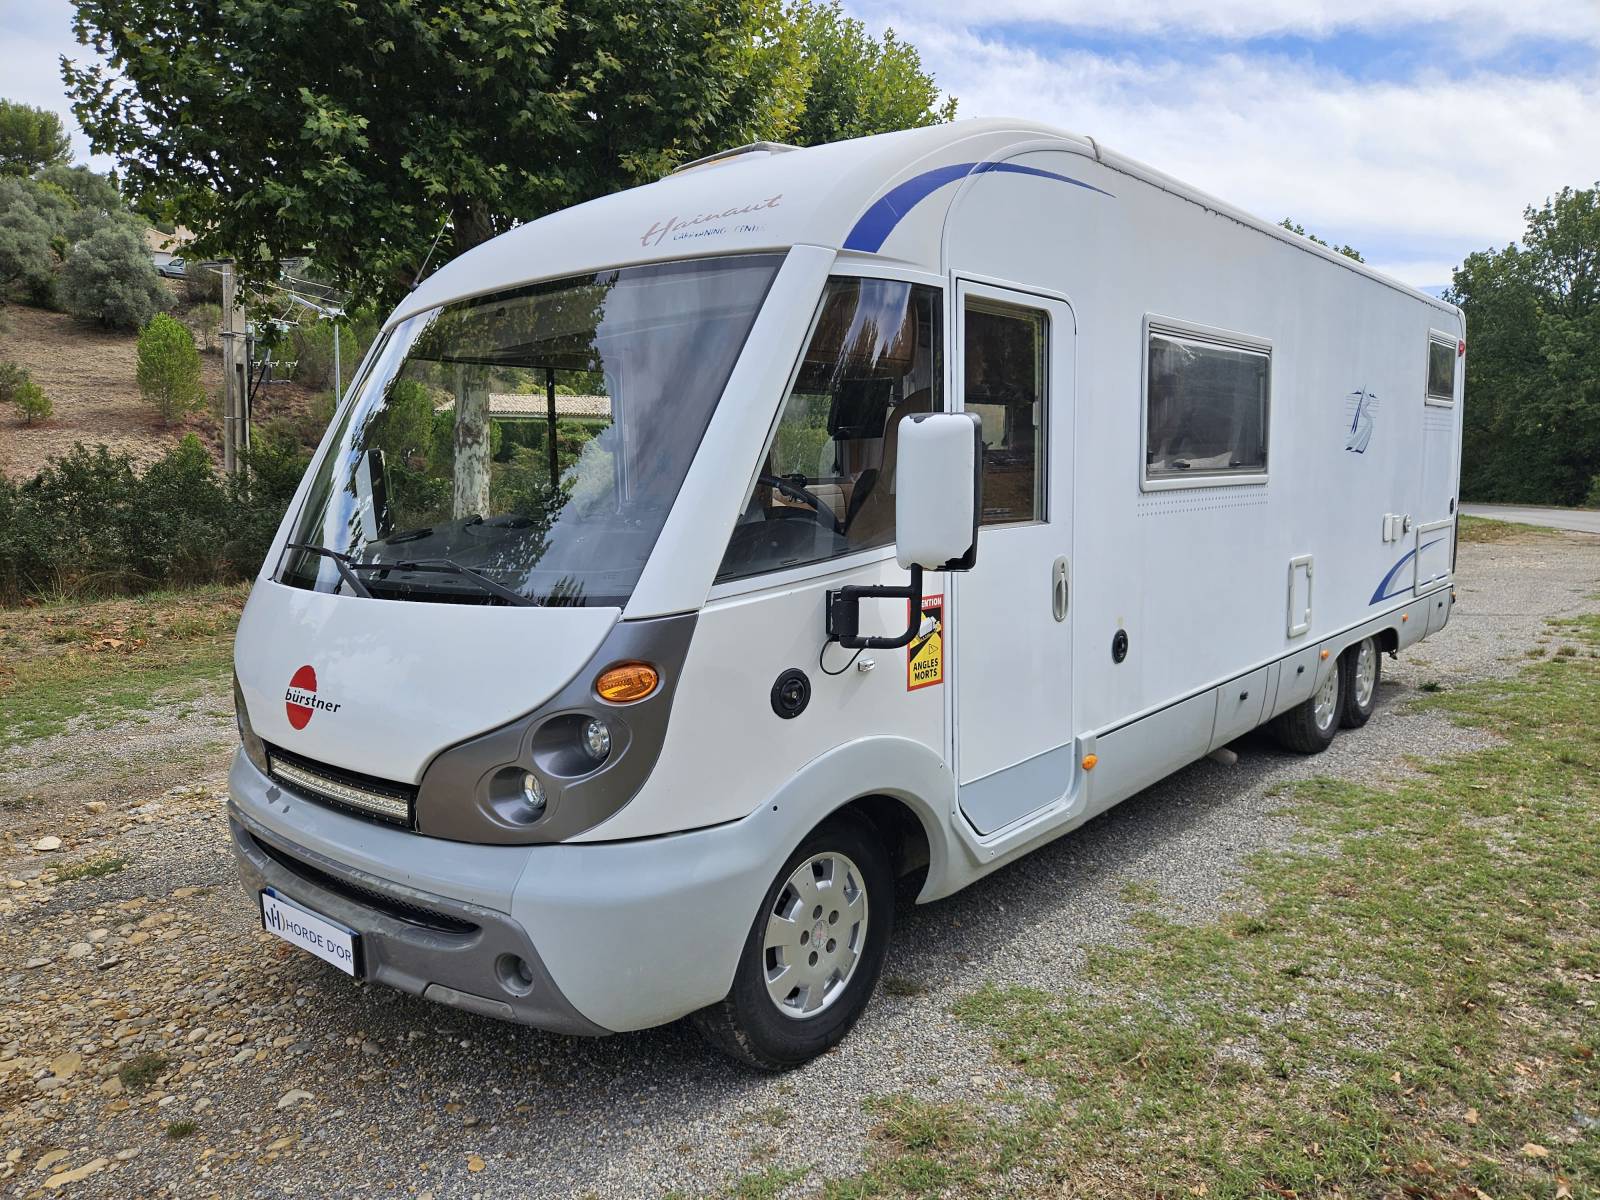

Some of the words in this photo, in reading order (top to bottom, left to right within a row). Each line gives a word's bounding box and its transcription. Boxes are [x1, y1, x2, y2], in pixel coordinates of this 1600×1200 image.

[640, 194, 783, 247] Hainaut
[921, 597, 942, 608] ENTION
[913, 658, 939, 672] ANGLES
[914, 668, 938, 681] MORTS
[285, 688, 341, 713] bürstner
[286, 919, 324, 948] HORDE
[326, 939, 352, 964] D'OR
